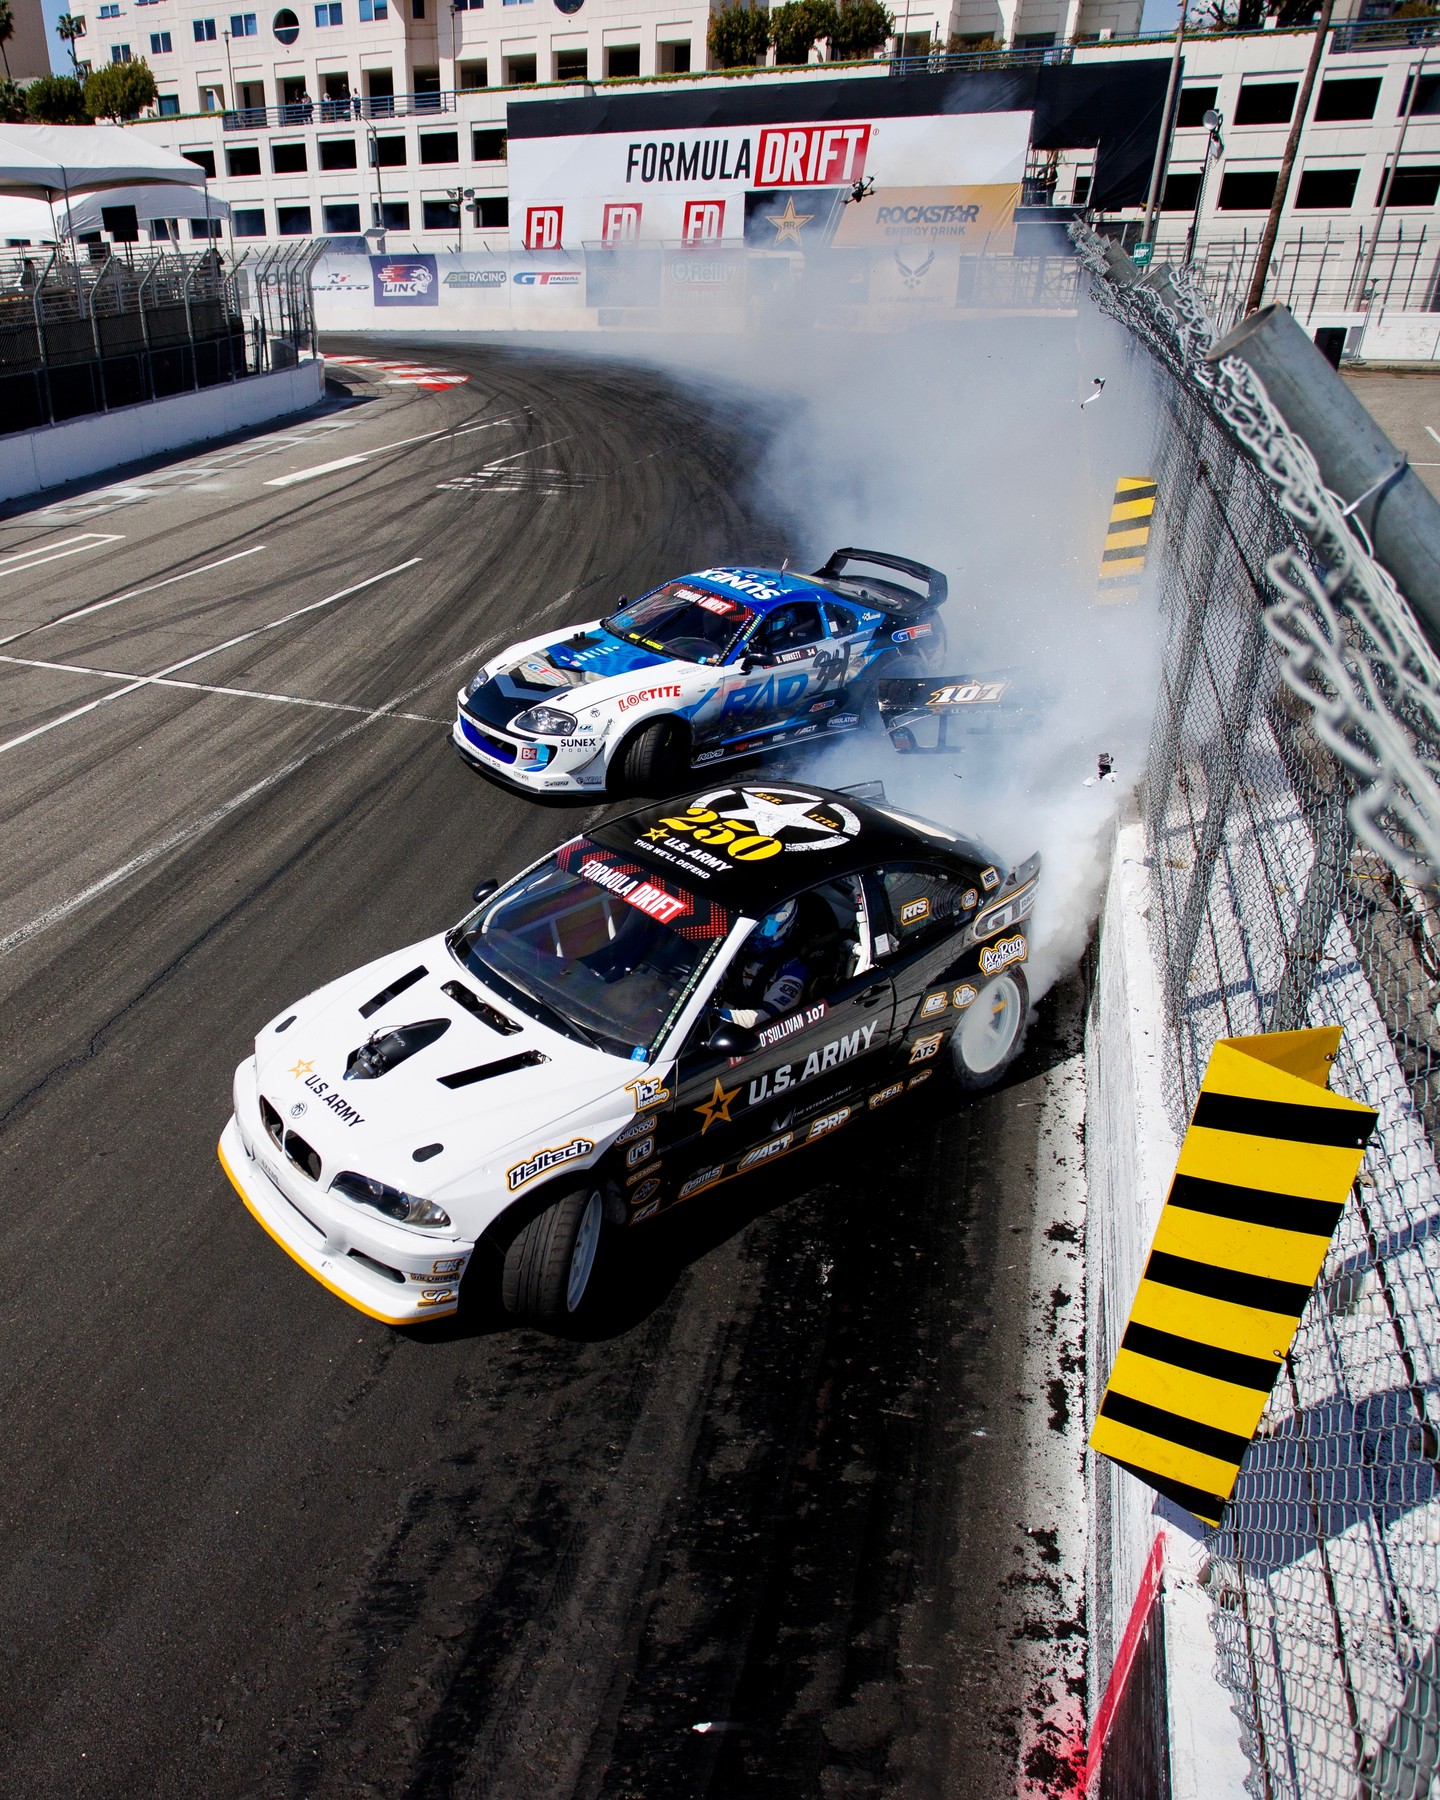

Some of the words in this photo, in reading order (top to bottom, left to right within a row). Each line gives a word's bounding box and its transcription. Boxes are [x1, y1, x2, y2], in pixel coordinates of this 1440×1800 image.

[626, 139, 750, 183] FORMULA
[761, 128, 865, 183] DRIFT
[606, 207, 637, 247] FD
[687, 204, 720, 246] FD
[876, 204, 980, 224] ROCKSTAR
[530, 209, 559, 249] FD
[885, 226, 928, 236] ENERGY
[931, 226, 967, 236] DRINK
[469, 273, 507, 284] RACING
[514, 272, 551, 285] GT
[670, 257, 738, 288] O'Reilly
[384, 283, 420, 292] LINK
[691, 569, 781, 600] SUNEX
[673, 588, 708, 604] FORMUA
[700, 597, 733, 614] DRIFT
[806, 648, 816, 657] 34
[618, 685, 681, 712] LOCTITE
[720, 674, 809, 722] RAD
[934, 682, 1007, 704] 107
[829, 716, 857, 725] PUROLATOR
[561, 738, 597, 748] SUNEX
[755, 792, 783, 805] EST.
[659, 807, 783, 861] 250
[635, 838, 653, 851] THIS
[653, 846, 677, 862] WE'LL
[675, 857, 710, 880] DEFEND
[663, 837, 688, 852] U.S.
[685, 845, 734, 872] ARMY
[577, 860, 639, 896] FORMULA
[627, 884, 684, 920] DRIFT
[759, 1014, 804, 1047] O'SULLIVAN
[806, 1004, 825, 1023] 107
[748, 1064, 796, 1105] U.S.
[801, 1019, 878, 1081] ARMY
[912, 1043, 937, 1061] ATS
[304, 1074, 329, 1097] U.S.
[322, 1093, 365, 1127] ARMY
[834, 1085, 853, 1098] TRUST
[881, 1085, 901, 1101] FEAL
[510, 1140, 592, 1188] Haltech
[748, 1135, 792, 1164] ACT
